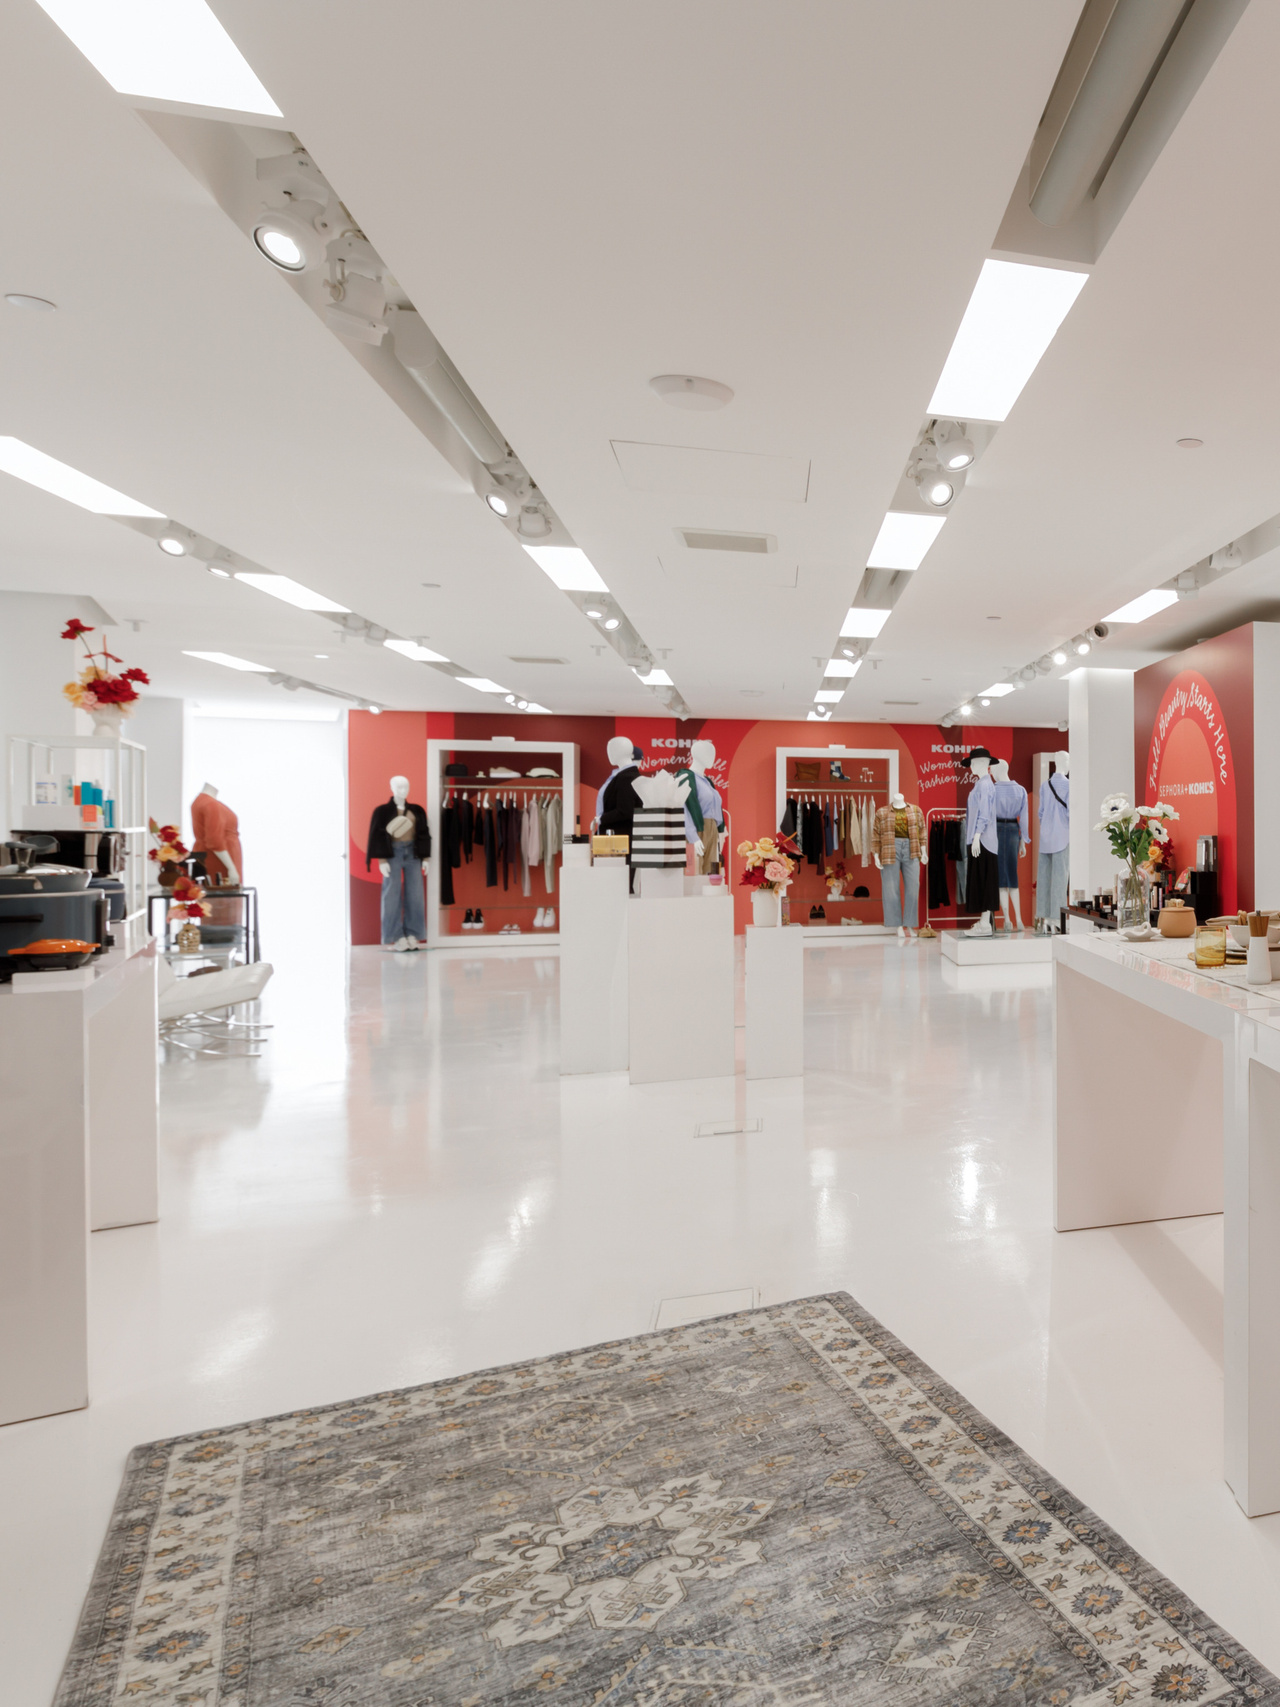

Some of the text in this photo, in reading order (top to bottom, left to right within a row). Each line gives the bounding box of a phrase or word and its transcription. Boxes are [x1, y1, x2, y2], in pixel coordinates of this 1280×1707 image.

[1159, 687, 1188, 741] Beauty
[1186, 682, 1215, 728] Starts
[1213, 725, 1228, 785] Here
[931, 744, 984, 753] KOHL'
[917, 773, 960, 792] Fashion
